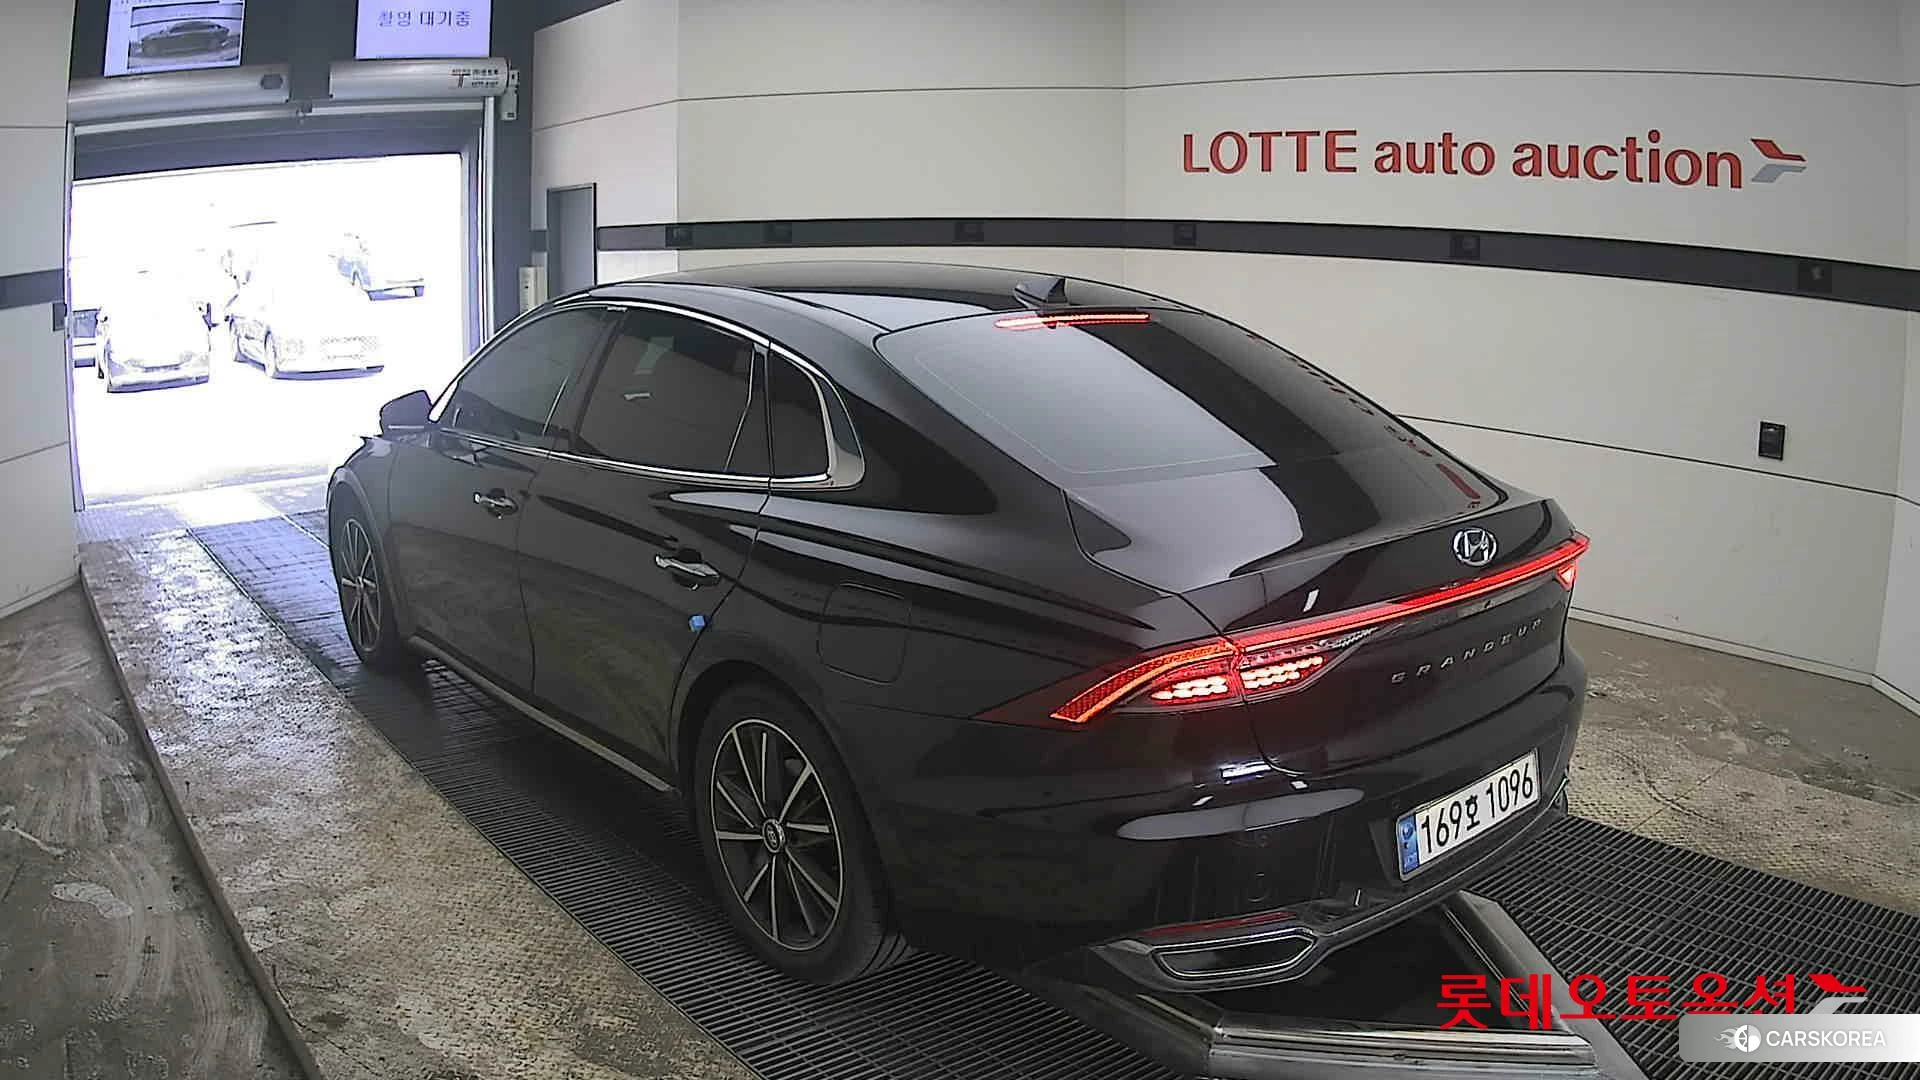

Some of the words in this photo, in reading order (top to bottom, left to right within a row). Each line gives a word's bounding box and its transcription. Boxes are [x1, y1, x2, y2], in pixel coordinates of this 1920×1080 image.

[420, 10, 471, 27] 대기중
[1183, 130, 1357, 174] LOTTE
[1374, 132, 1496, 176] auto
[1512, 129, 1742, 189] auction
[1391, 618, 1543, 684] GRANDEUR
[1421, 793, 1480, 854] 169호
[1486, 762, 1533, 818] 1096
